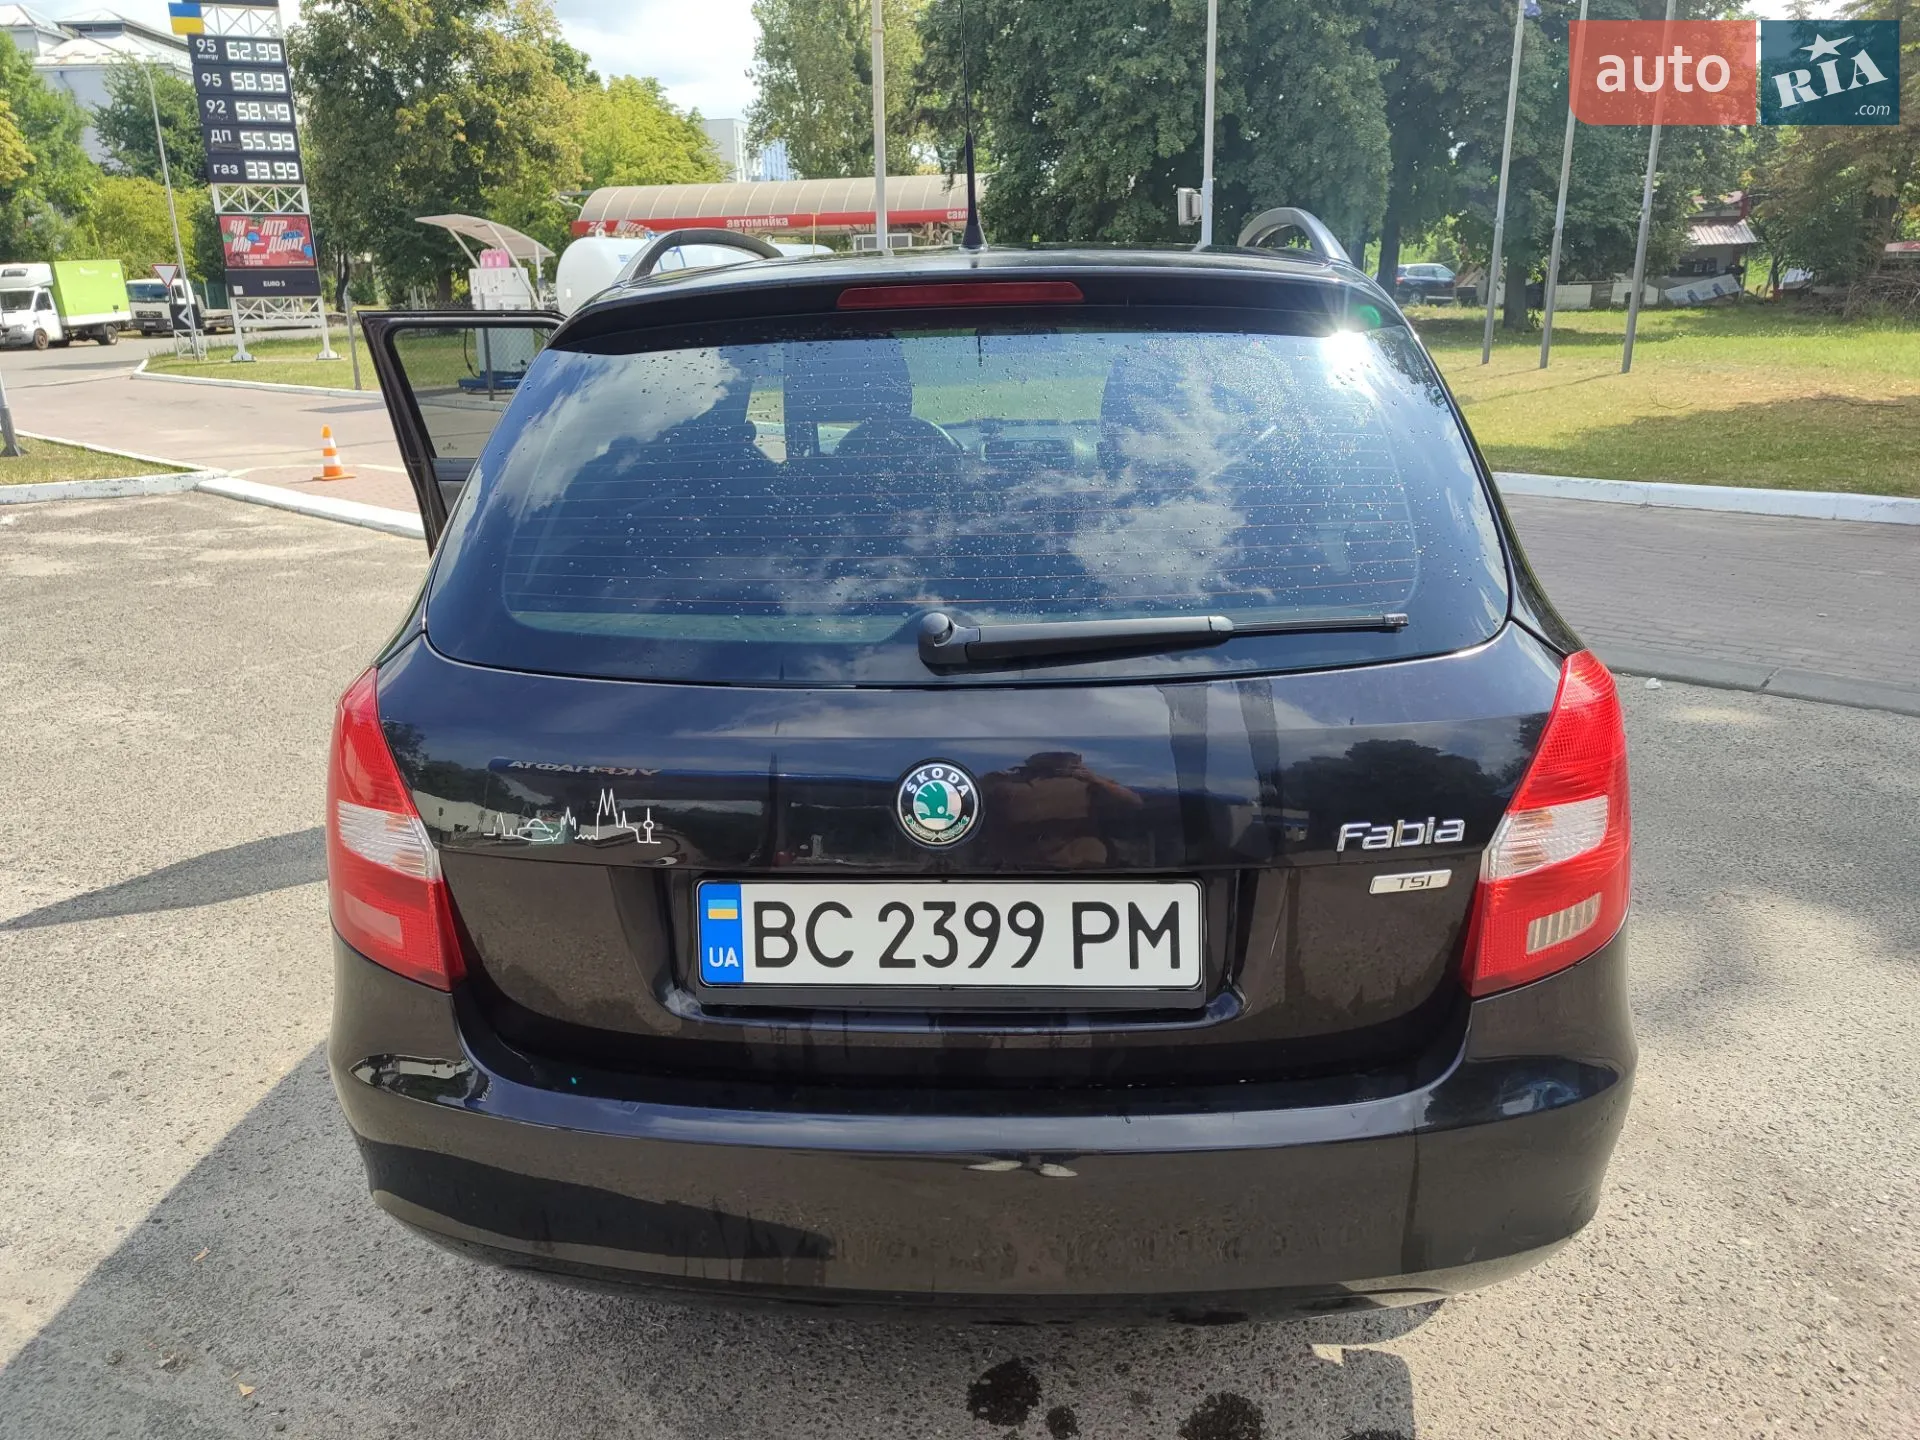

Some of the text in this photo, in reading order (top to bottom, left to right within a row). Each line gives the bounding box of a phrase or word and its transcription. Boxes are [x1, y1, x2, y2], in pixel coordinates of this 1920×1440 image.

[196, 38, 282, 62] 95 62.99
[201, 72, 287, 92] 95 58.99
[205, 99, 227, 114] 92
[235, 102, 291, 121] 58.49
[210, 129, 232, 143] ДП
[240, 131, 296, 151] 55.99
[213, 161, 300, 180] газ 33.99
[726, 216, 789, 228] автомийка
[946, 210, 968, 220] сам
[1336, 816, 1466, 852] Fabia
[1397, 875, 1432, 889] TSI
[754, 901, 1181, 969] BC 2399 PM
[708, 946, 739, 967] UA
